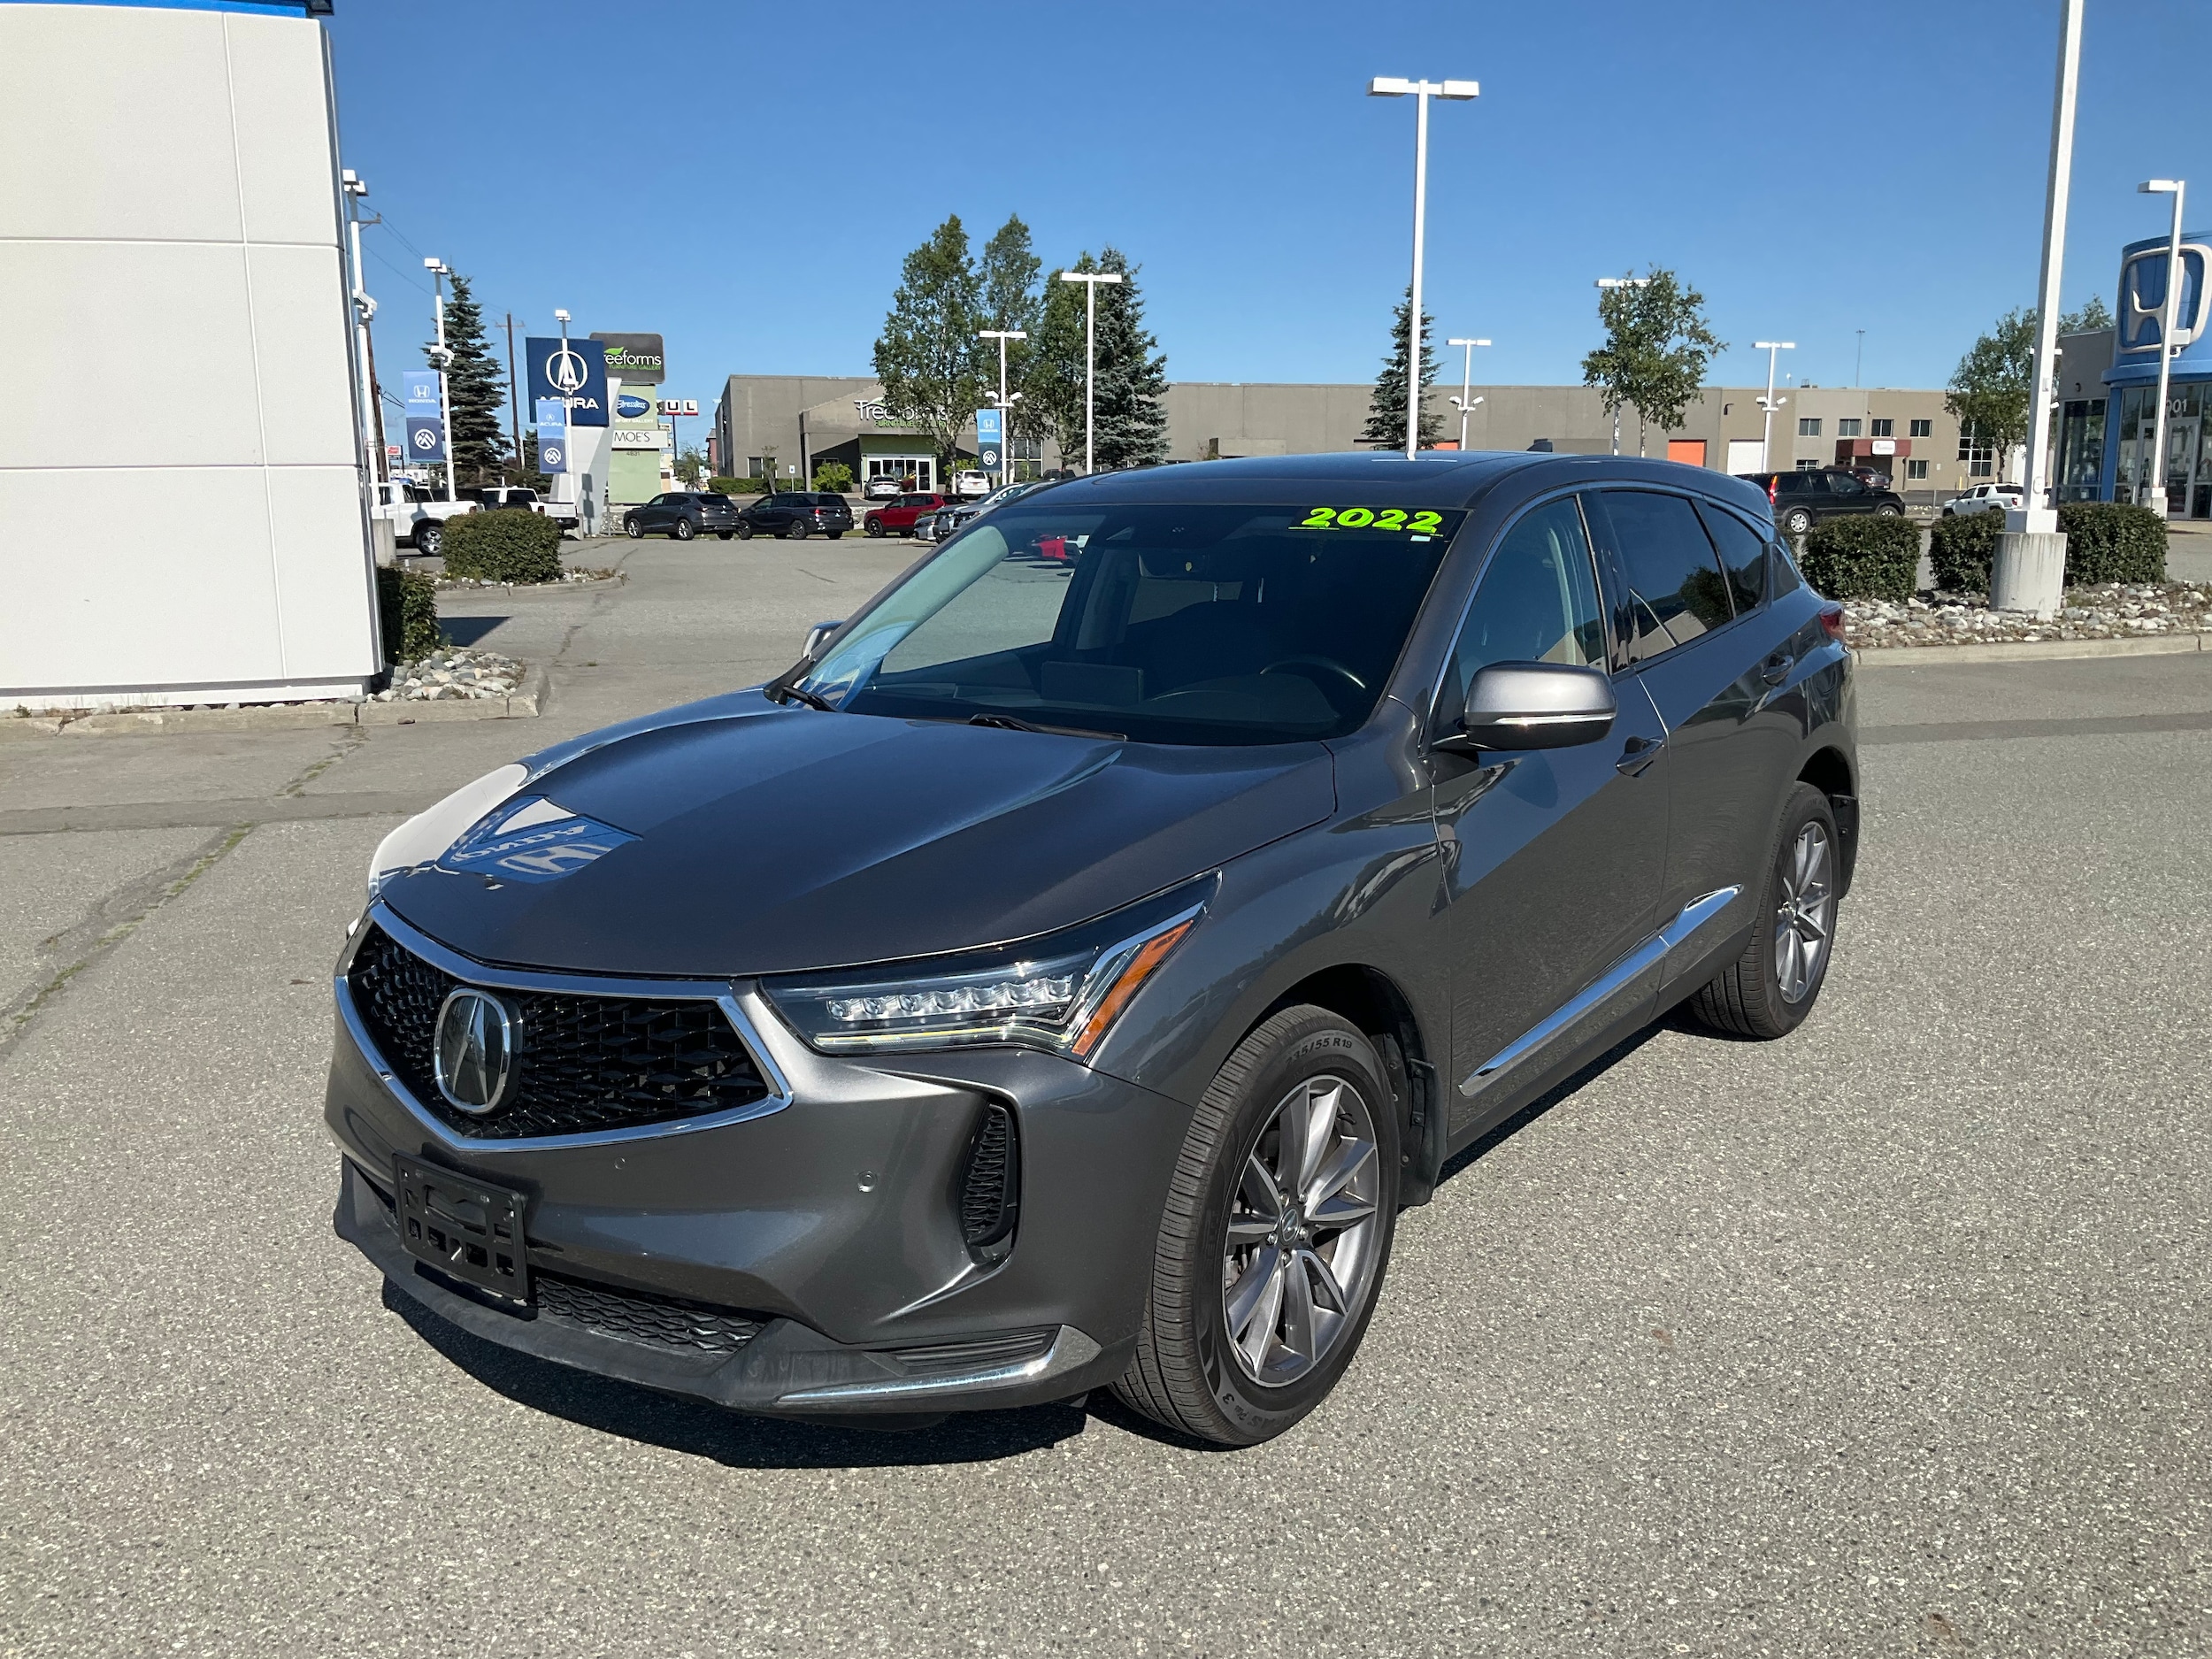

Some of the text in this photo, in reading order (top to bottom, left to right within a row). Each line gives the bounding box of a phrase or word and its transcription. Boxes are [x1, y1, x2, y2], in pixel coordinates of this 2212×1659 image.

[603, 349, 662, 365] eeforms
[540, 396, 599, 409] URA
[614, 431, 650, 442] MOE'S
[1301, 507, 1444, 534] 2022
[1333, 1037, 1353, 1048] R19
[1222, 1393, 1234, 1405] 3
